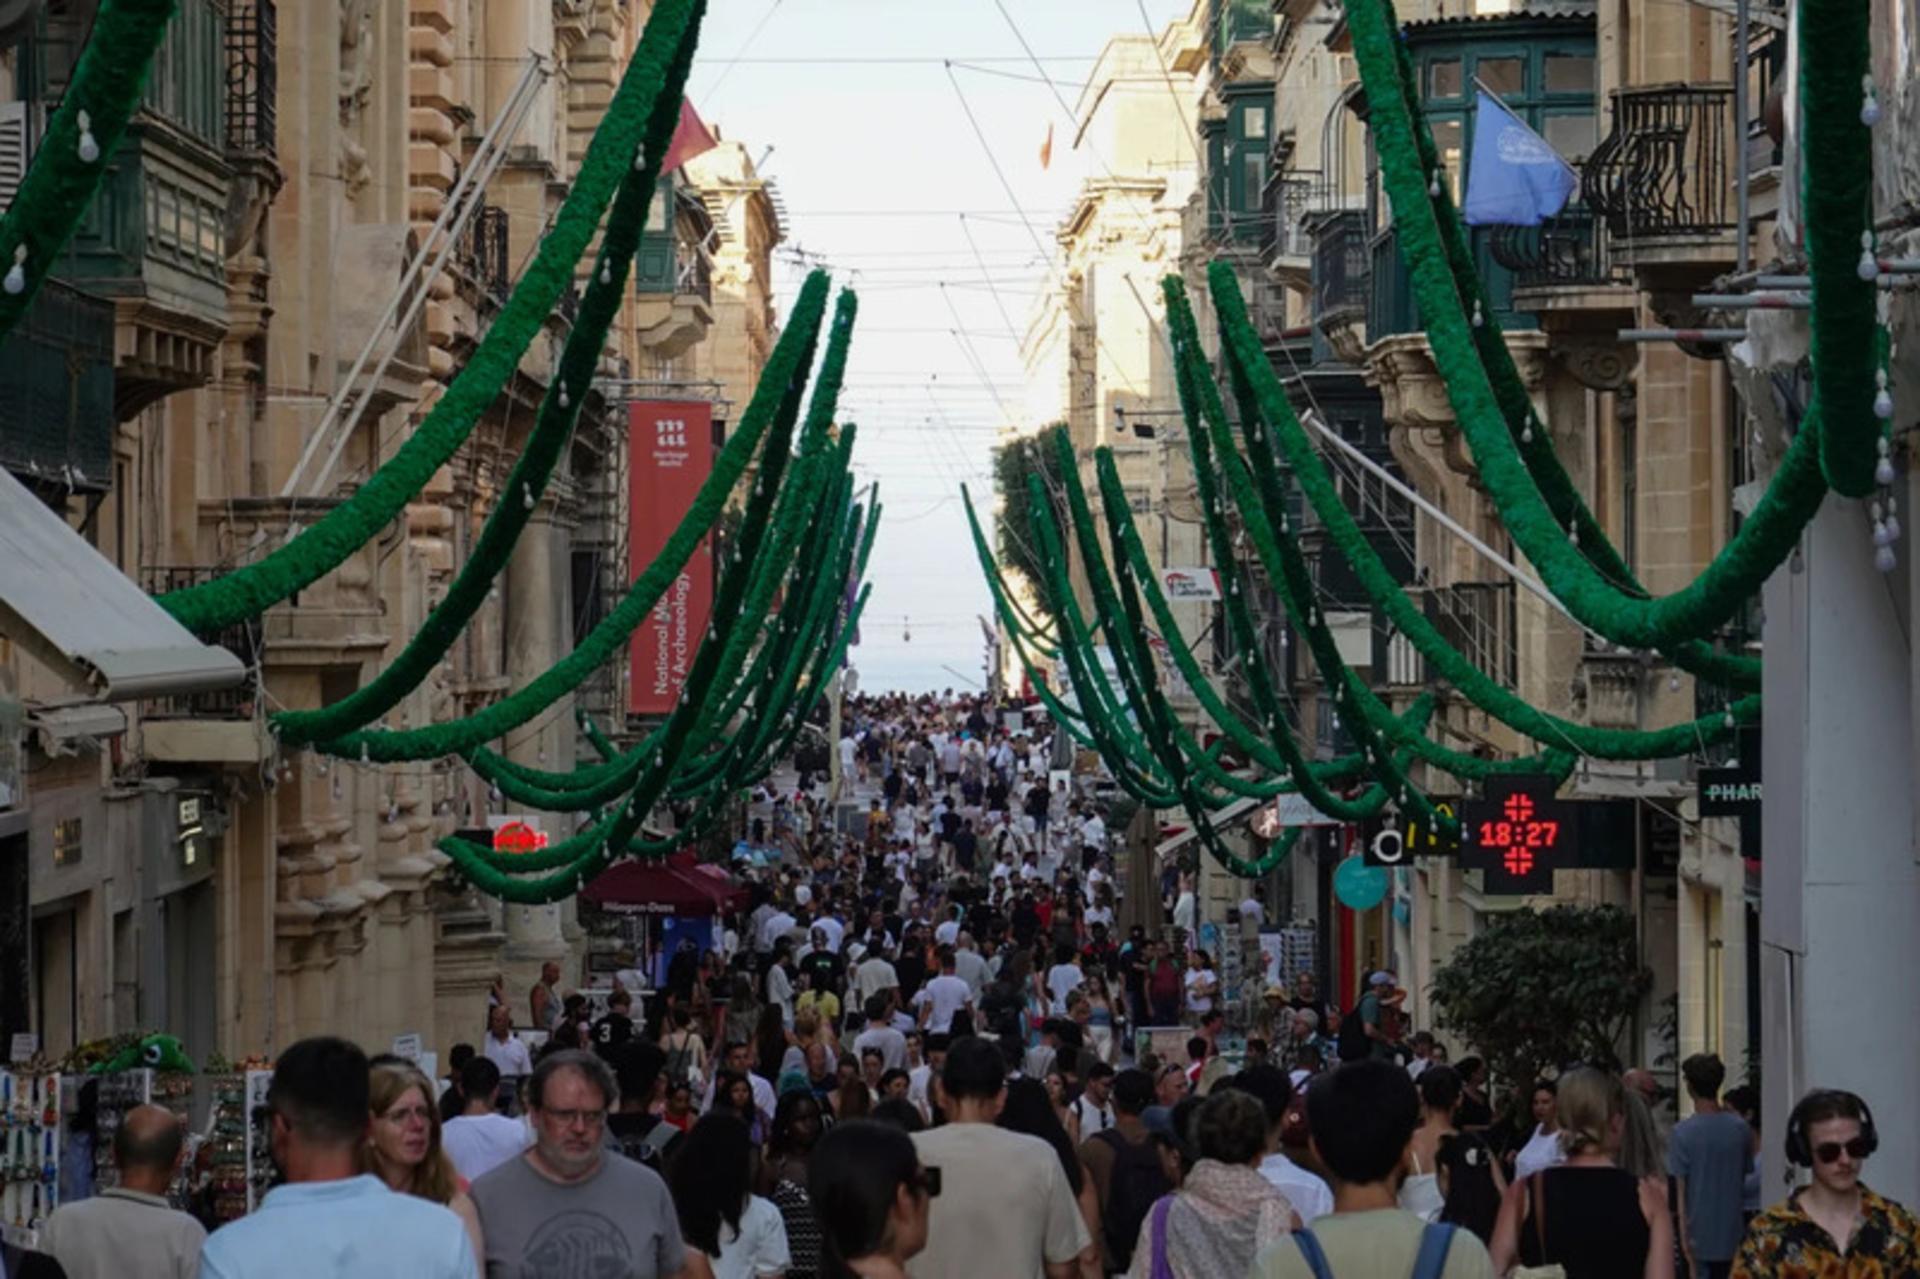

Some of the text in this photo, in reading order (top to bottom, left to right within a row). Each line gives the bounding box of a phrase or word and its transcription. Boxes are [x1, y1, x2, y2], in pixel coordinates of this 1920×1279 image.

[671, 572, 690, 674] Archaeology
[653, 624, 669, 694] National
[1709, 783, 1762, 801] PHAR
[1480, 821, 1558, 847] 18:27
[600, 1023, 611, 1042] 3
